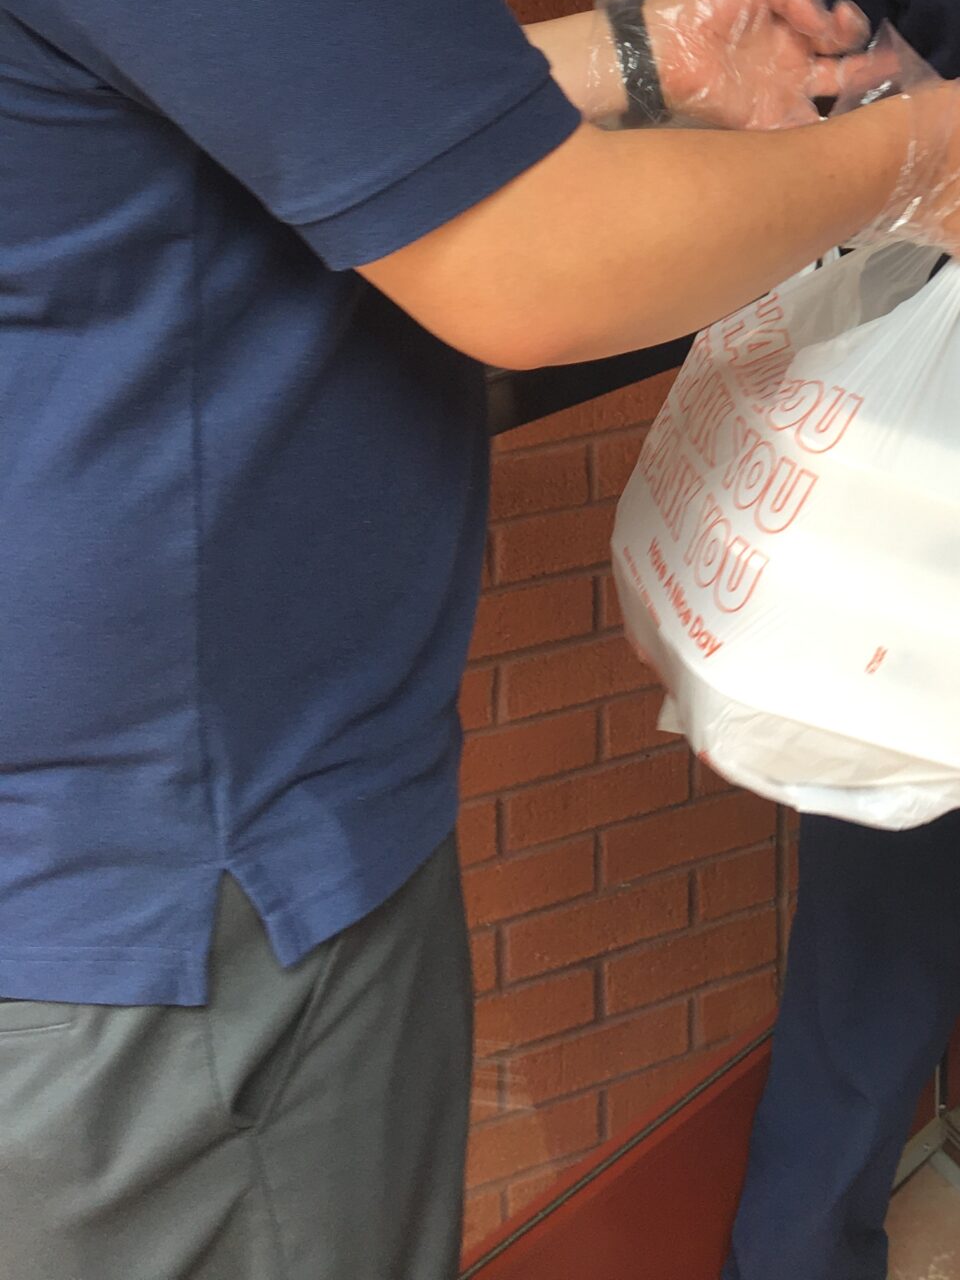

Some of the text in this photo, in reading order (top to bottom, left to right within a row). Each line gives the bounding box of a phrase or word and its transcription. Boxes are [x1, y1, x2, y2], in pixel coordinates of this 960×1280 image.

[723, 415, 819, 534] YOU
[684, 492, 771, 613] YOU
[688, 615, 724, 659] Day
